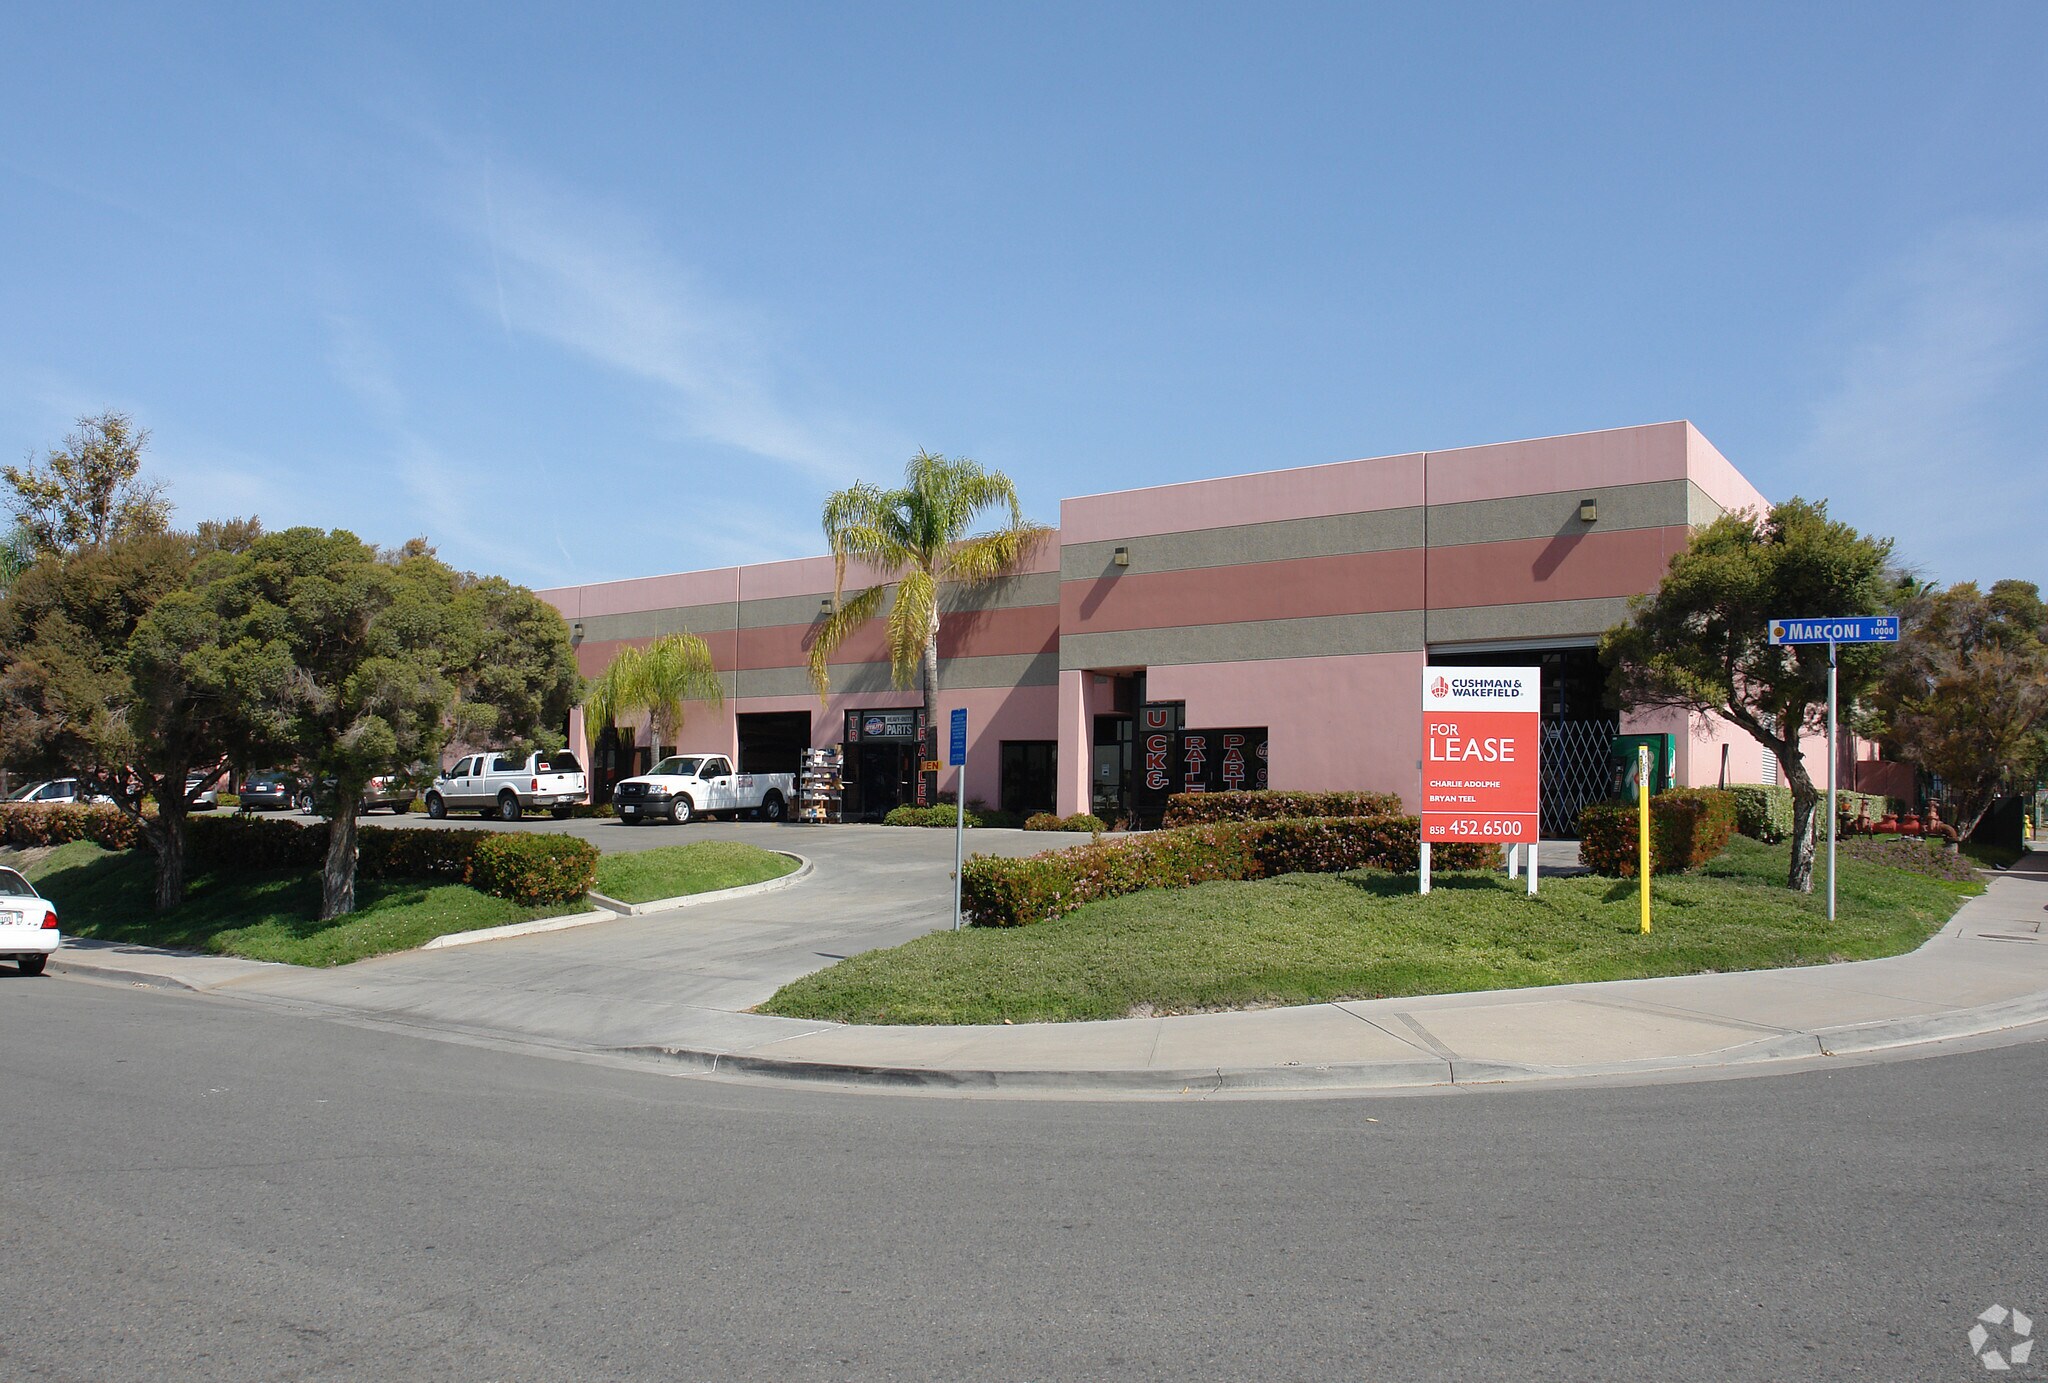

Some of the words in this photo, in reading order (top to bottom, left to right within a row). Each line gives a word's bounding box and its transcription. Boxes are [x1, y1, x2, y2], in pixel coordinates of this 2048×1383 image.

[1788, 623, 1860, 640] MARCONI
[1870, 627, 1894, 635] 10000
[1451, 679, 1512, 688] CUSHMAN
[1513, 679, 1522, 688] &
[1452, 688, 1520, 697] WAKEFIELD
[886, 724, 913, 735] PARTS
[1430, 723, 1459, 736] FOR
[1430, 737, 1515, 762] LEASE
[1223, 734, 1246, 792] PART
[1430, 780, 1463, 788] CHARLIE
[1458, 795, 1476, 803] TEEL
[1429, 826, 1446, 835] 858
[1449, 820, 1522, 836] 452.6500
